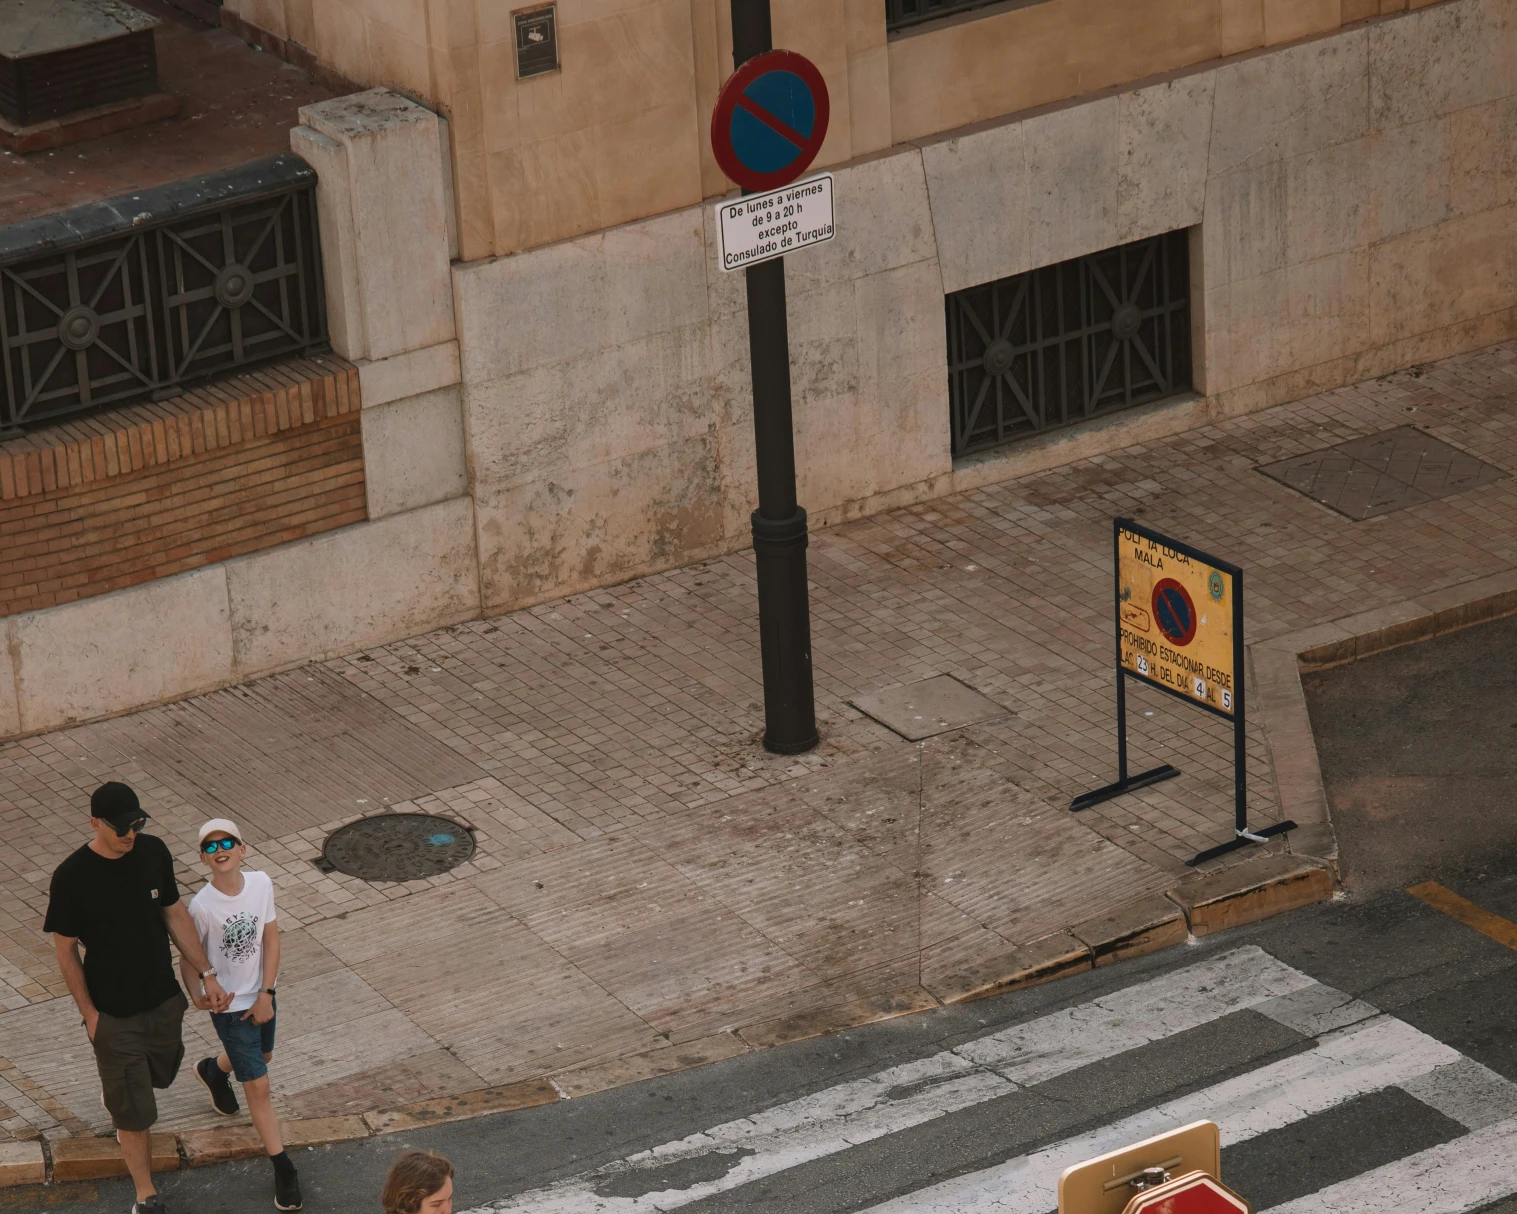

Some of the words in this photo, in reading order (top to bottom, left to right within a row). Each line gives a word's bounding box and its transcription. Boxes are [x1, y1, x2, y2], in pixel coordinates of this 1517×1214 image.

[730, 207, 743, 218] De
[747, 198, 773, 214] lunes
[777, 196, 783, 204] a
[786, 184, 823, 202] viernes
[752, 215, 763, 227] de
[766, 212, 772, 222] 9
[775, 211, 780, 220] a
[783, 205, 794, 218] 20
[797, 202, 802, 213] h
[726, 241, 777, 264] Consulado
[780, 237, 792, 248] de
[796, 224, 832, 243] Turquía
[758, 221, 798, 240] excepto
[1120, 528, 1158, 552] POLIIA
[1135, 548, 1164, 570] MALA
[1120, 628, 1157, 656] PROHIBIDO
[1160, 645, 1203, 676] ESTACIONAR
[1207, 666, 1231, 688] DESDE
[1137, 655, 1148, 671] 23
[1160, 666, 1174, 684] DEL
[1196, 682, 1204, 696] 4
[1207, 687, 1216, 702] AL
[1224, 692, 1230, 708] 5
